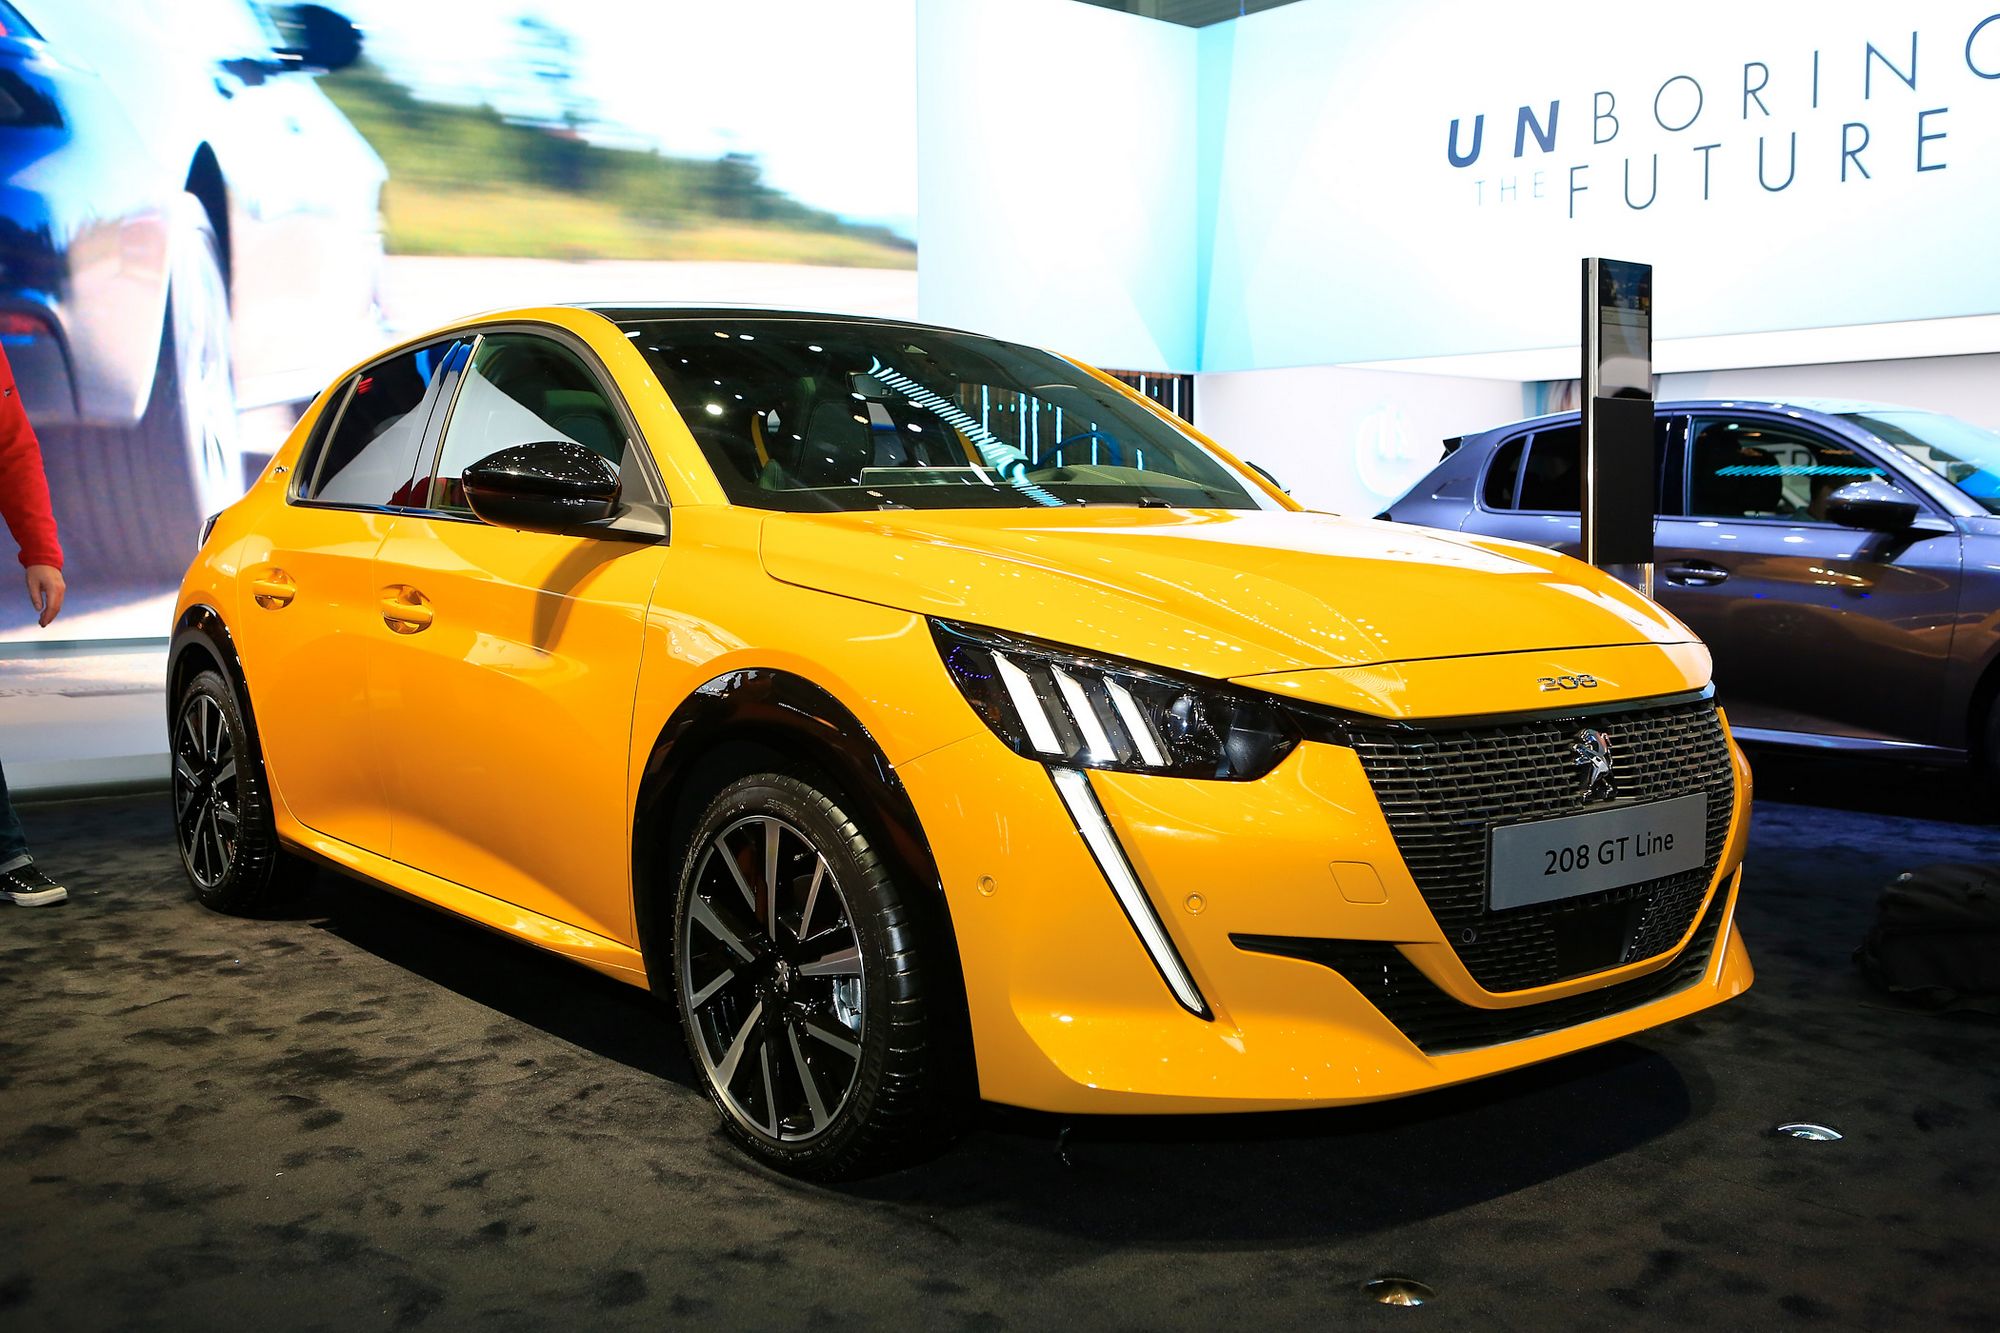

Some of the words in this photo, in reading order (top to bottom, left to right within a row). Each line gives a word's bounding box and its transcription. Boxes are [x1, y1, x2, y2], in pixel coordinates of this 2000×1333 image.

[1475, 171, 1544, 206] THE
[1569, 107, 1949, 219] FUTURE
[1537, 674, 1598, 692] 208
[1544, 844, 1589, 875] 208
[1597, 836, 1629, 865] GT
[1636, 832, 1674, 857] Line
